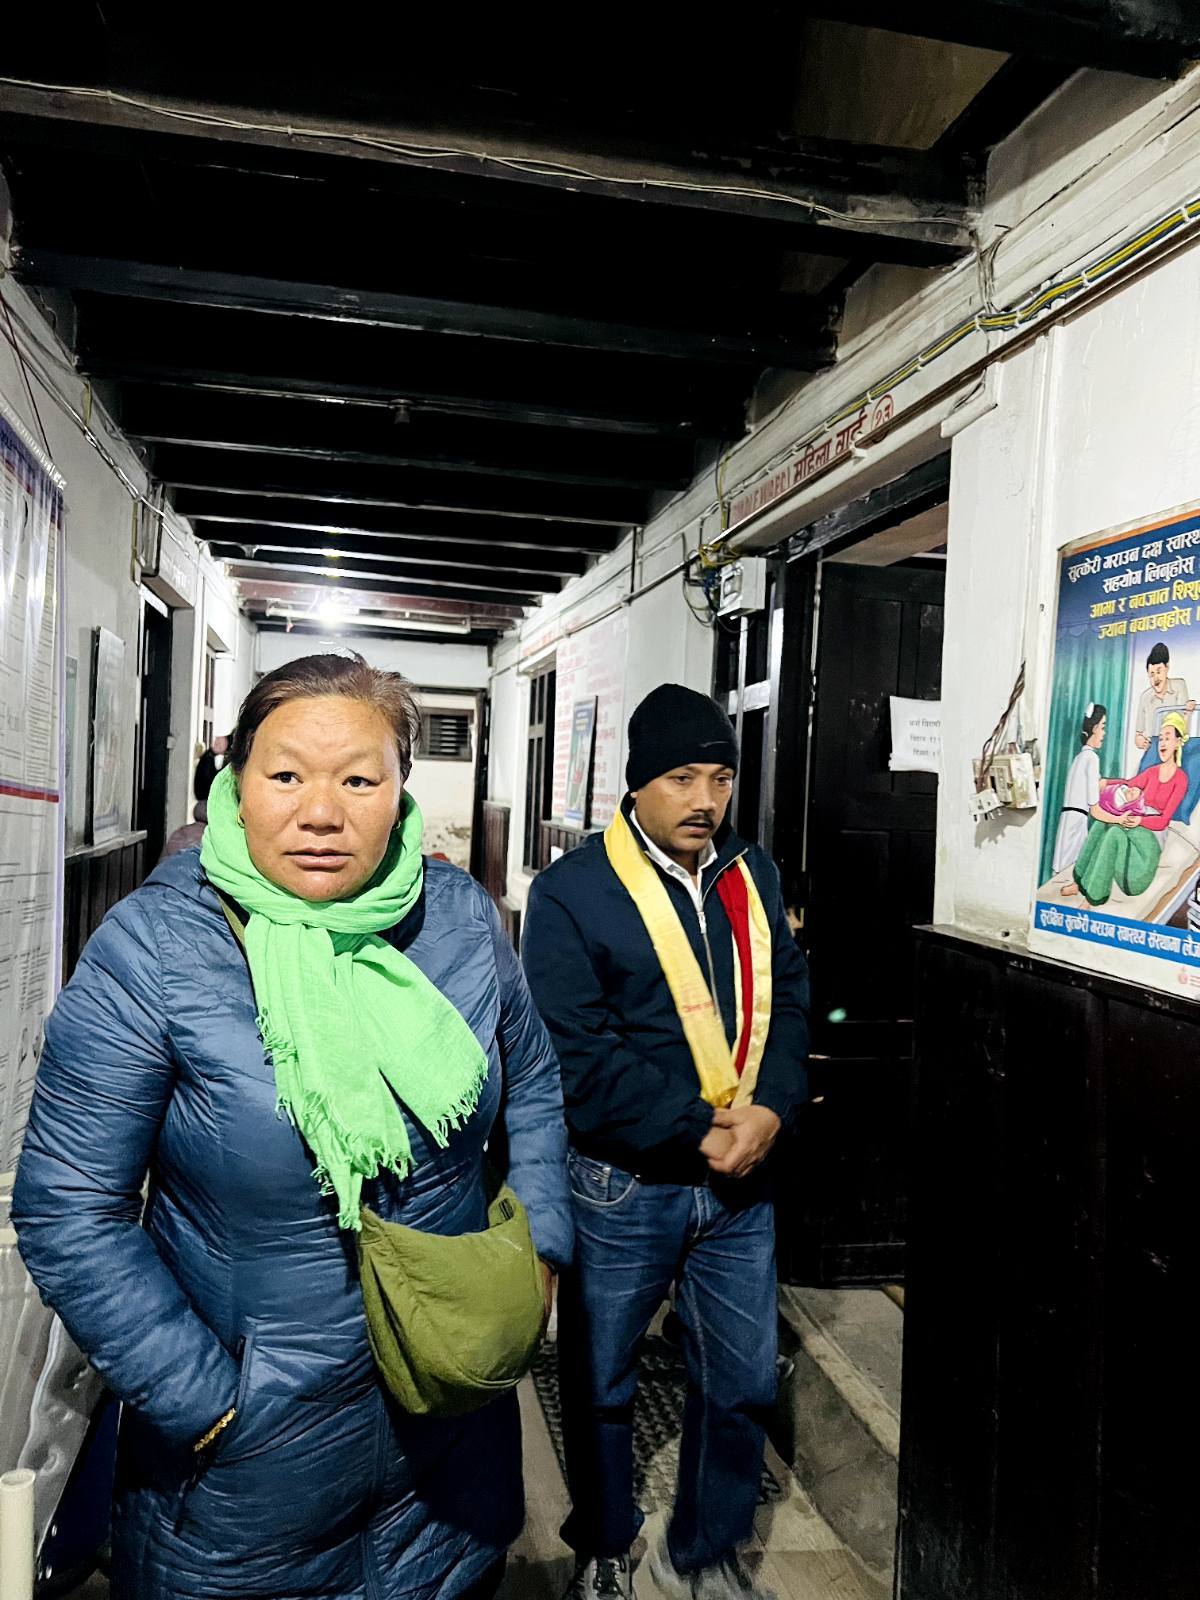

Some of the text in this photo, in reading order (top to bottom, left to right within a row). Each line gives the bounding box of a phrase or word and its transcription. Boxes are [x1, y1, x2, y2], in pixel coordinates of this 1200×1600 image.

[793, 442, 832, 484] महिला
[1068, 555, 1102, 583] सुत्केरी
[1103, 547, 1140, 569] गराउन
[1141, 540, 1164, 559] दक्ष
[1102, 556, 1195, 594] सहयोग लिनुहोस्
[1090, 600, 1116, 618] आमा
[1118, 597, 1127, 612] र
[1129, 587, 1170, 609] नवजात
[1098, 621, 1127, 640] ज्यान
